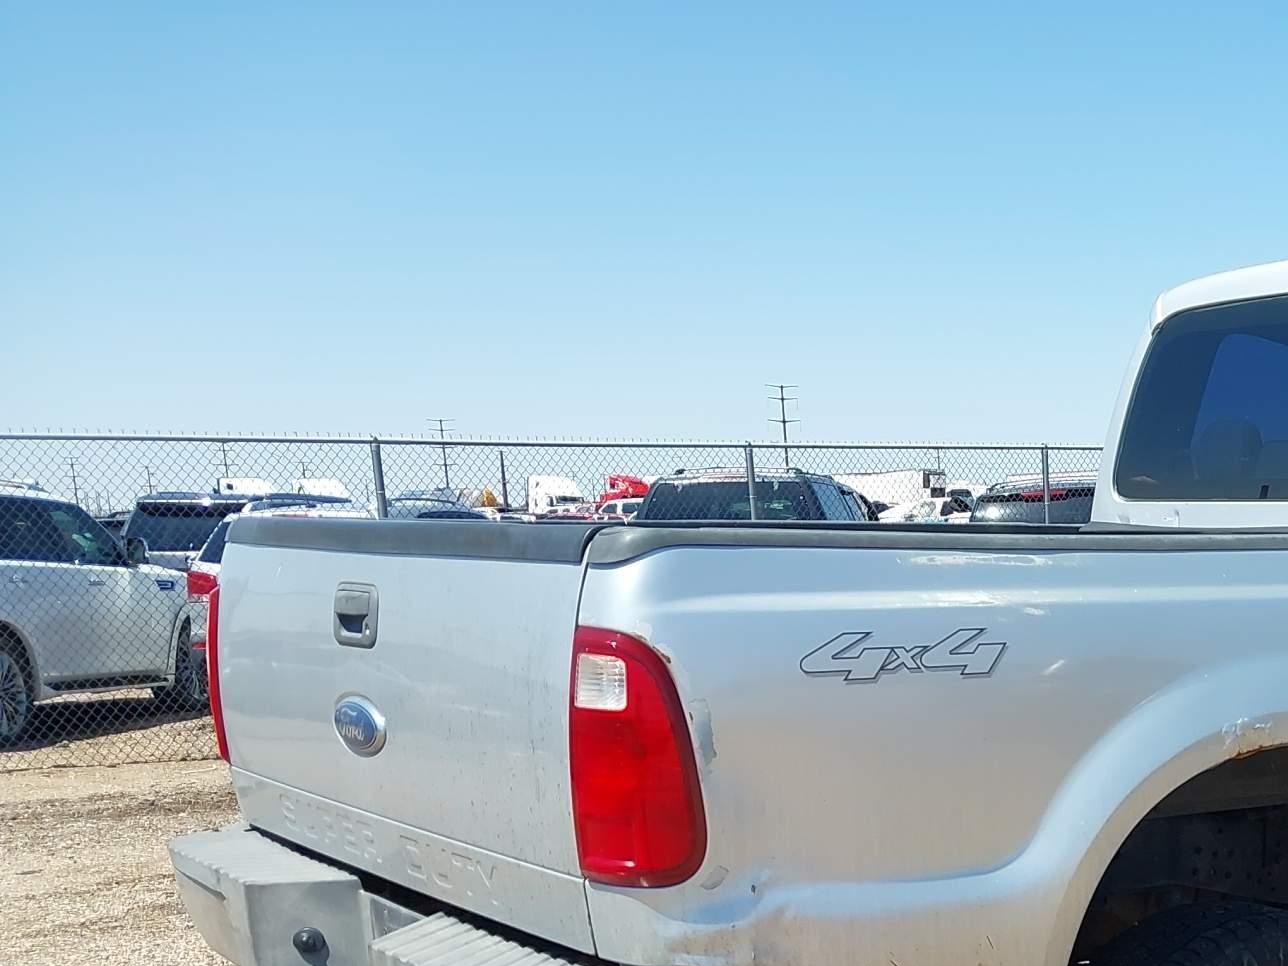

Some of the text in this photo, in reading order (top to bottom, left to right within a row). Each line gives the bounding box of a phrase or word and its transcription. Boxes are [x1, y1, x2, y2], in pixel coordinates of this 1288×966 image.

[799, 628, 1008, 684] 4x4
[280, 793, 499, 905] SUPER DUTY
